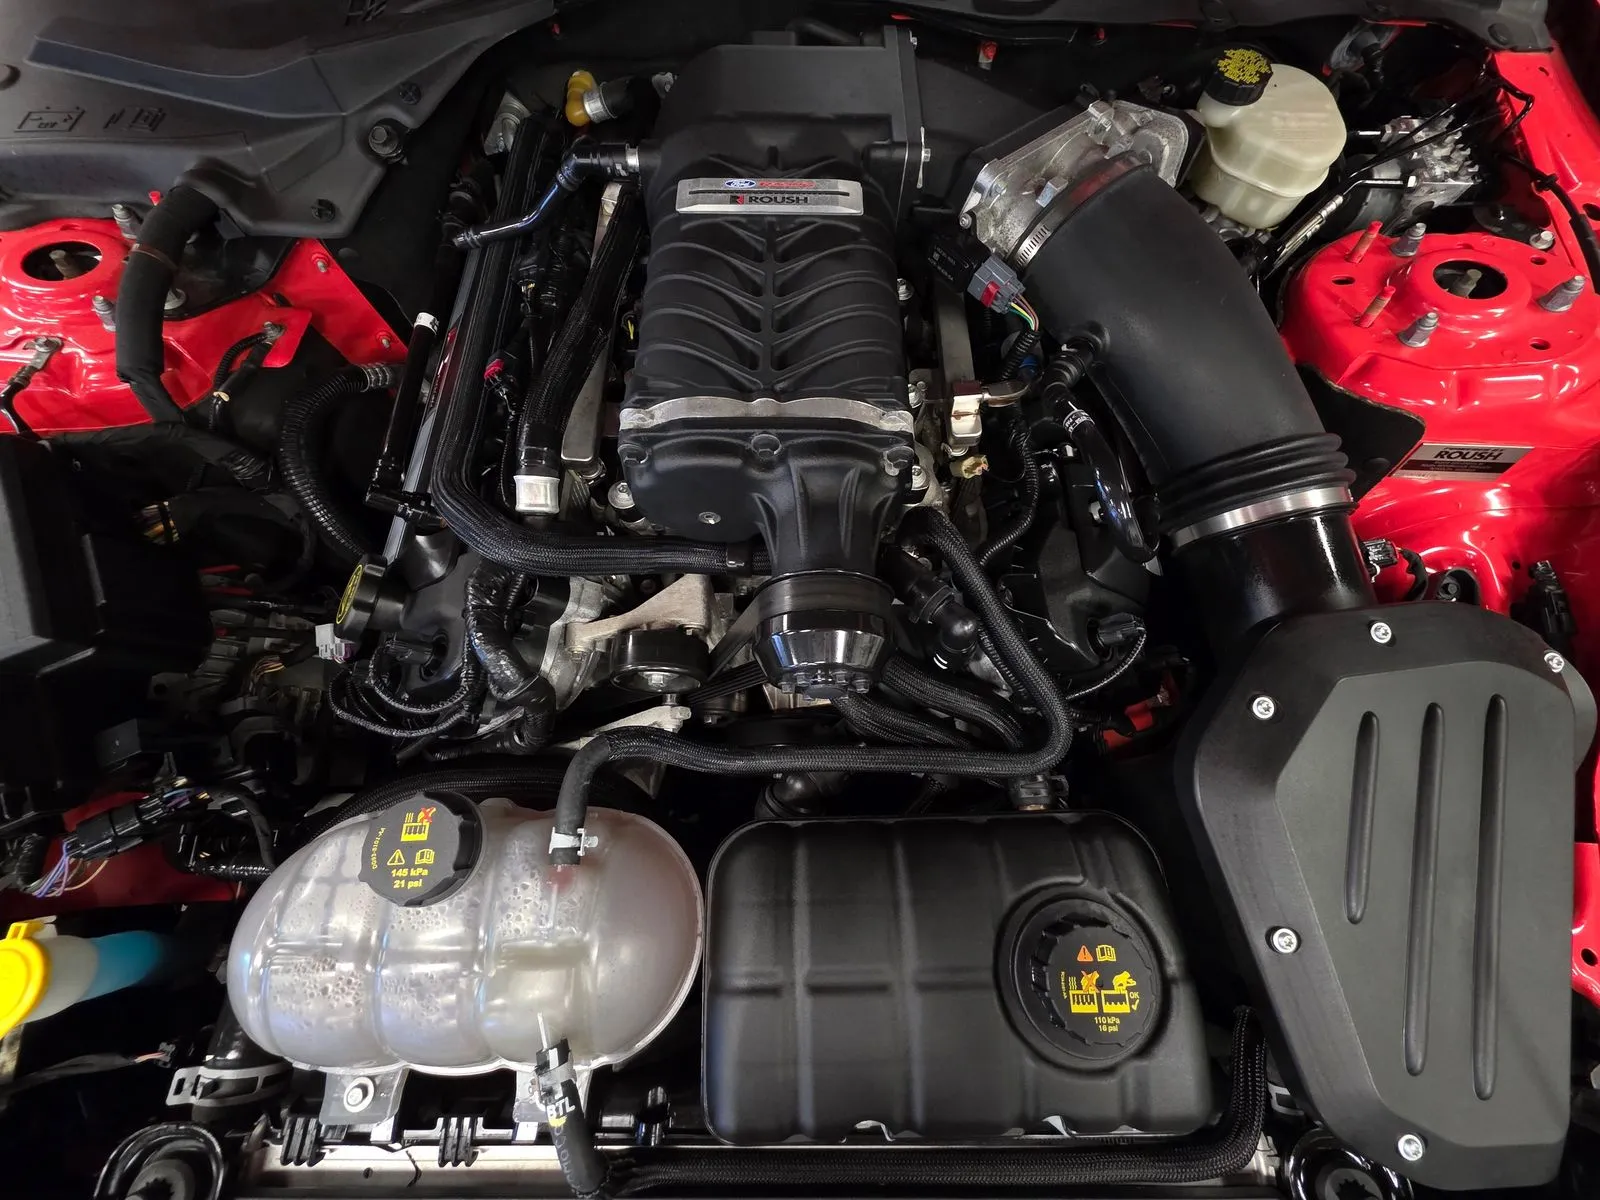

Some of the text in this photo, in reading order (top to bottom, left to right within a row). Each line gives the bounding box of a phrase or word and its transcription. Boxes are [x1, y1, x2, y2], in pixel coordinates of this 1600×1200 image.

[749, 196, 808, 204] ROUSH
[1434, 450, 1502, 461] ROUSH
[391, 868, 428, 877] 145 kPa
[393, 879, 422, 889] 21 psi
[1129, 991, 1140, 999] OK
[1094, 1016, 1120, 1024] 110 kPa
[1098, 1024, 1118, 1033] 16 psi
[547, 1096, 575, 1119] BTL
